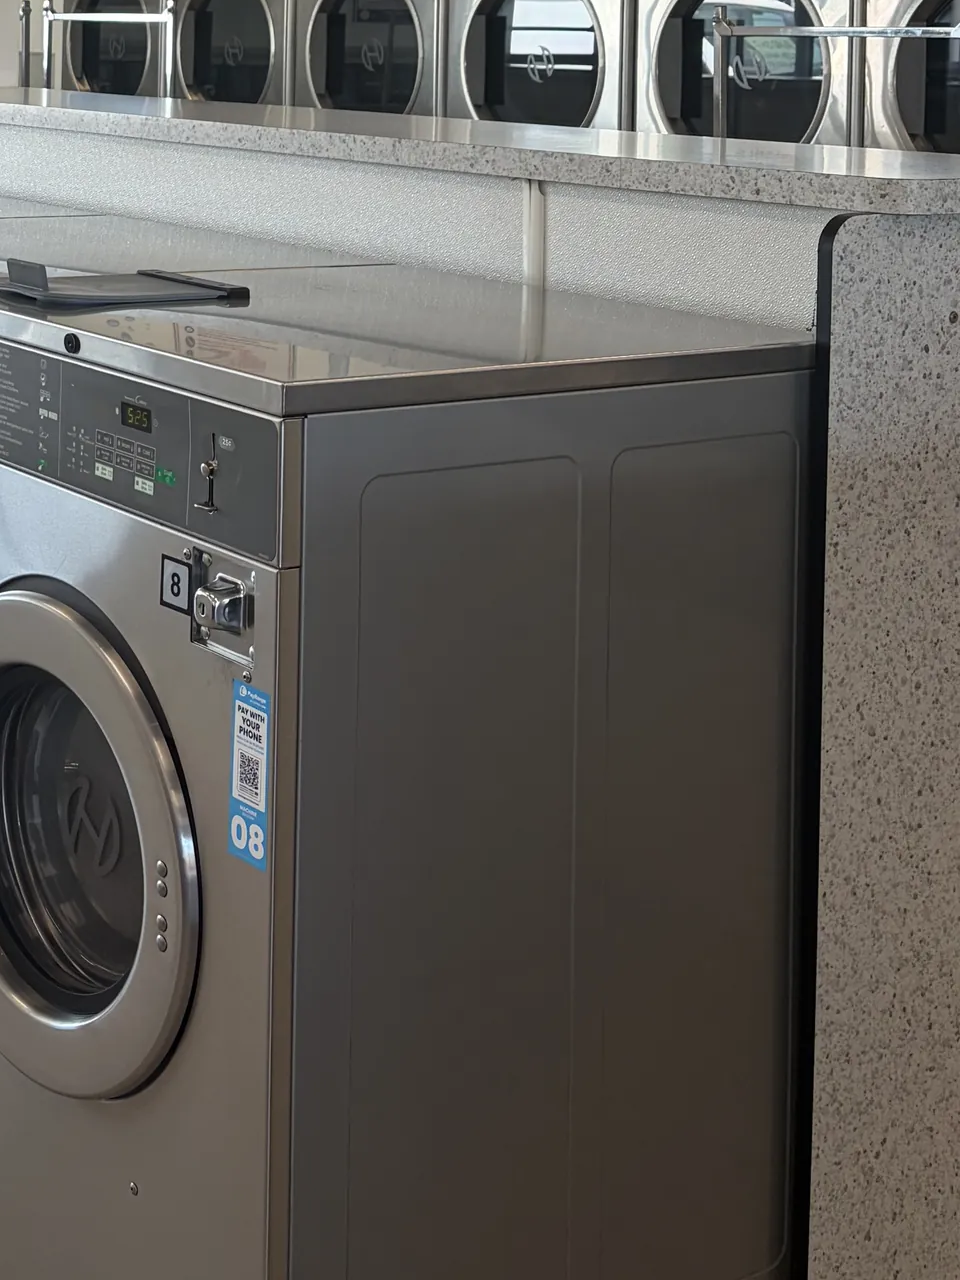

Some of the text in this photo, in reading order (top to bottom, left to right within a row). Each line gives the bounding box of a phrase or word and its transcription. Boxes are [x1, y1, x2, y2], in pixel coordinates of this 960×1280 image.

[170, 572, 181, 598] 8
[237, 704, 266, 725] PAY WITH
[241, 716, 261, 733] YOUR
[238, 725, 263, 745] PHONE
[231, 815, 265, 860] 08
